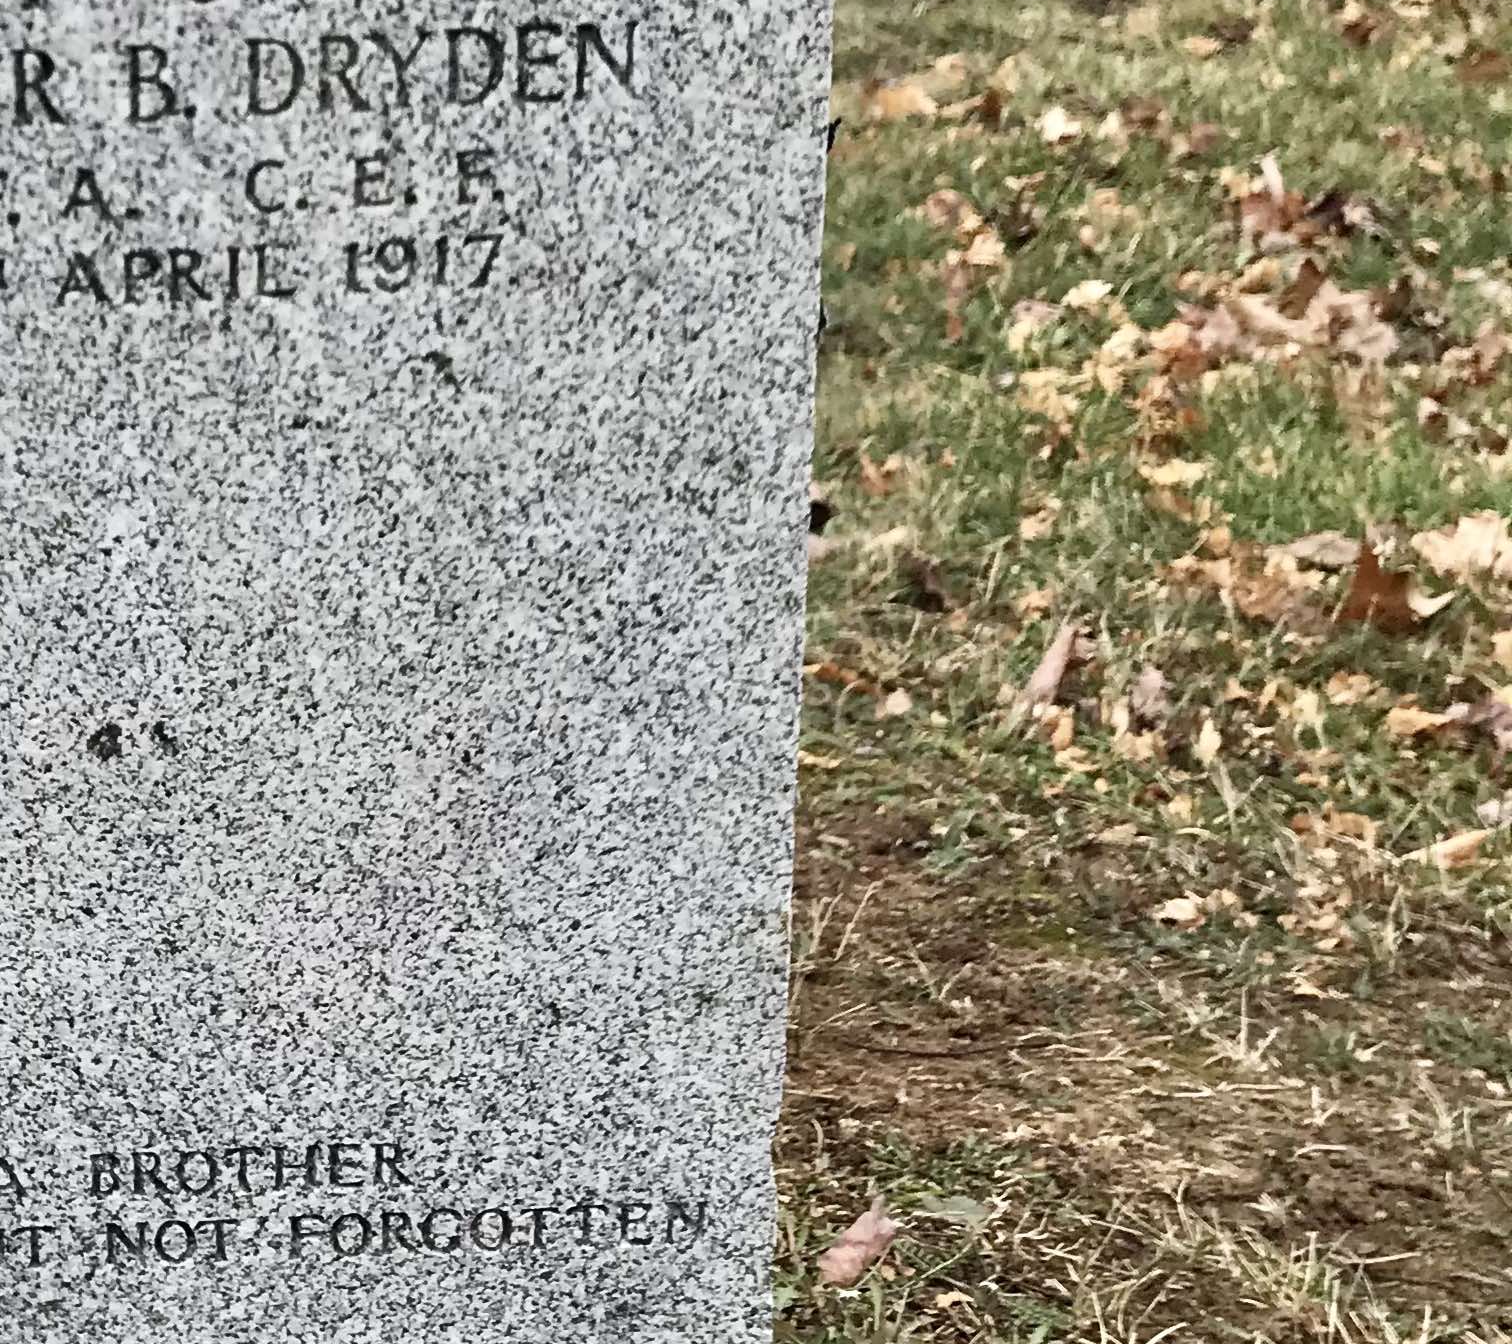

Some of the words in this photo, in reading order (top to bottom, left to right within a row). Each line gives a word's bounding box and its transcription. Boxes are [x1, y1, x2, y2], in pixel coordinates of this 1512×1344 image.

[124, 43, 197, 122] B.
[246, 22, 640, 116] DRYDEN
[57, 243, 298, 306] APRIL
[344, 233, 504, 293] 1917
[89, 1142, 412, 1200] BROTHER
[105, 1217, 237, 1262] NOT
[290, 1201, 708, 1258] FORGOTTEN
